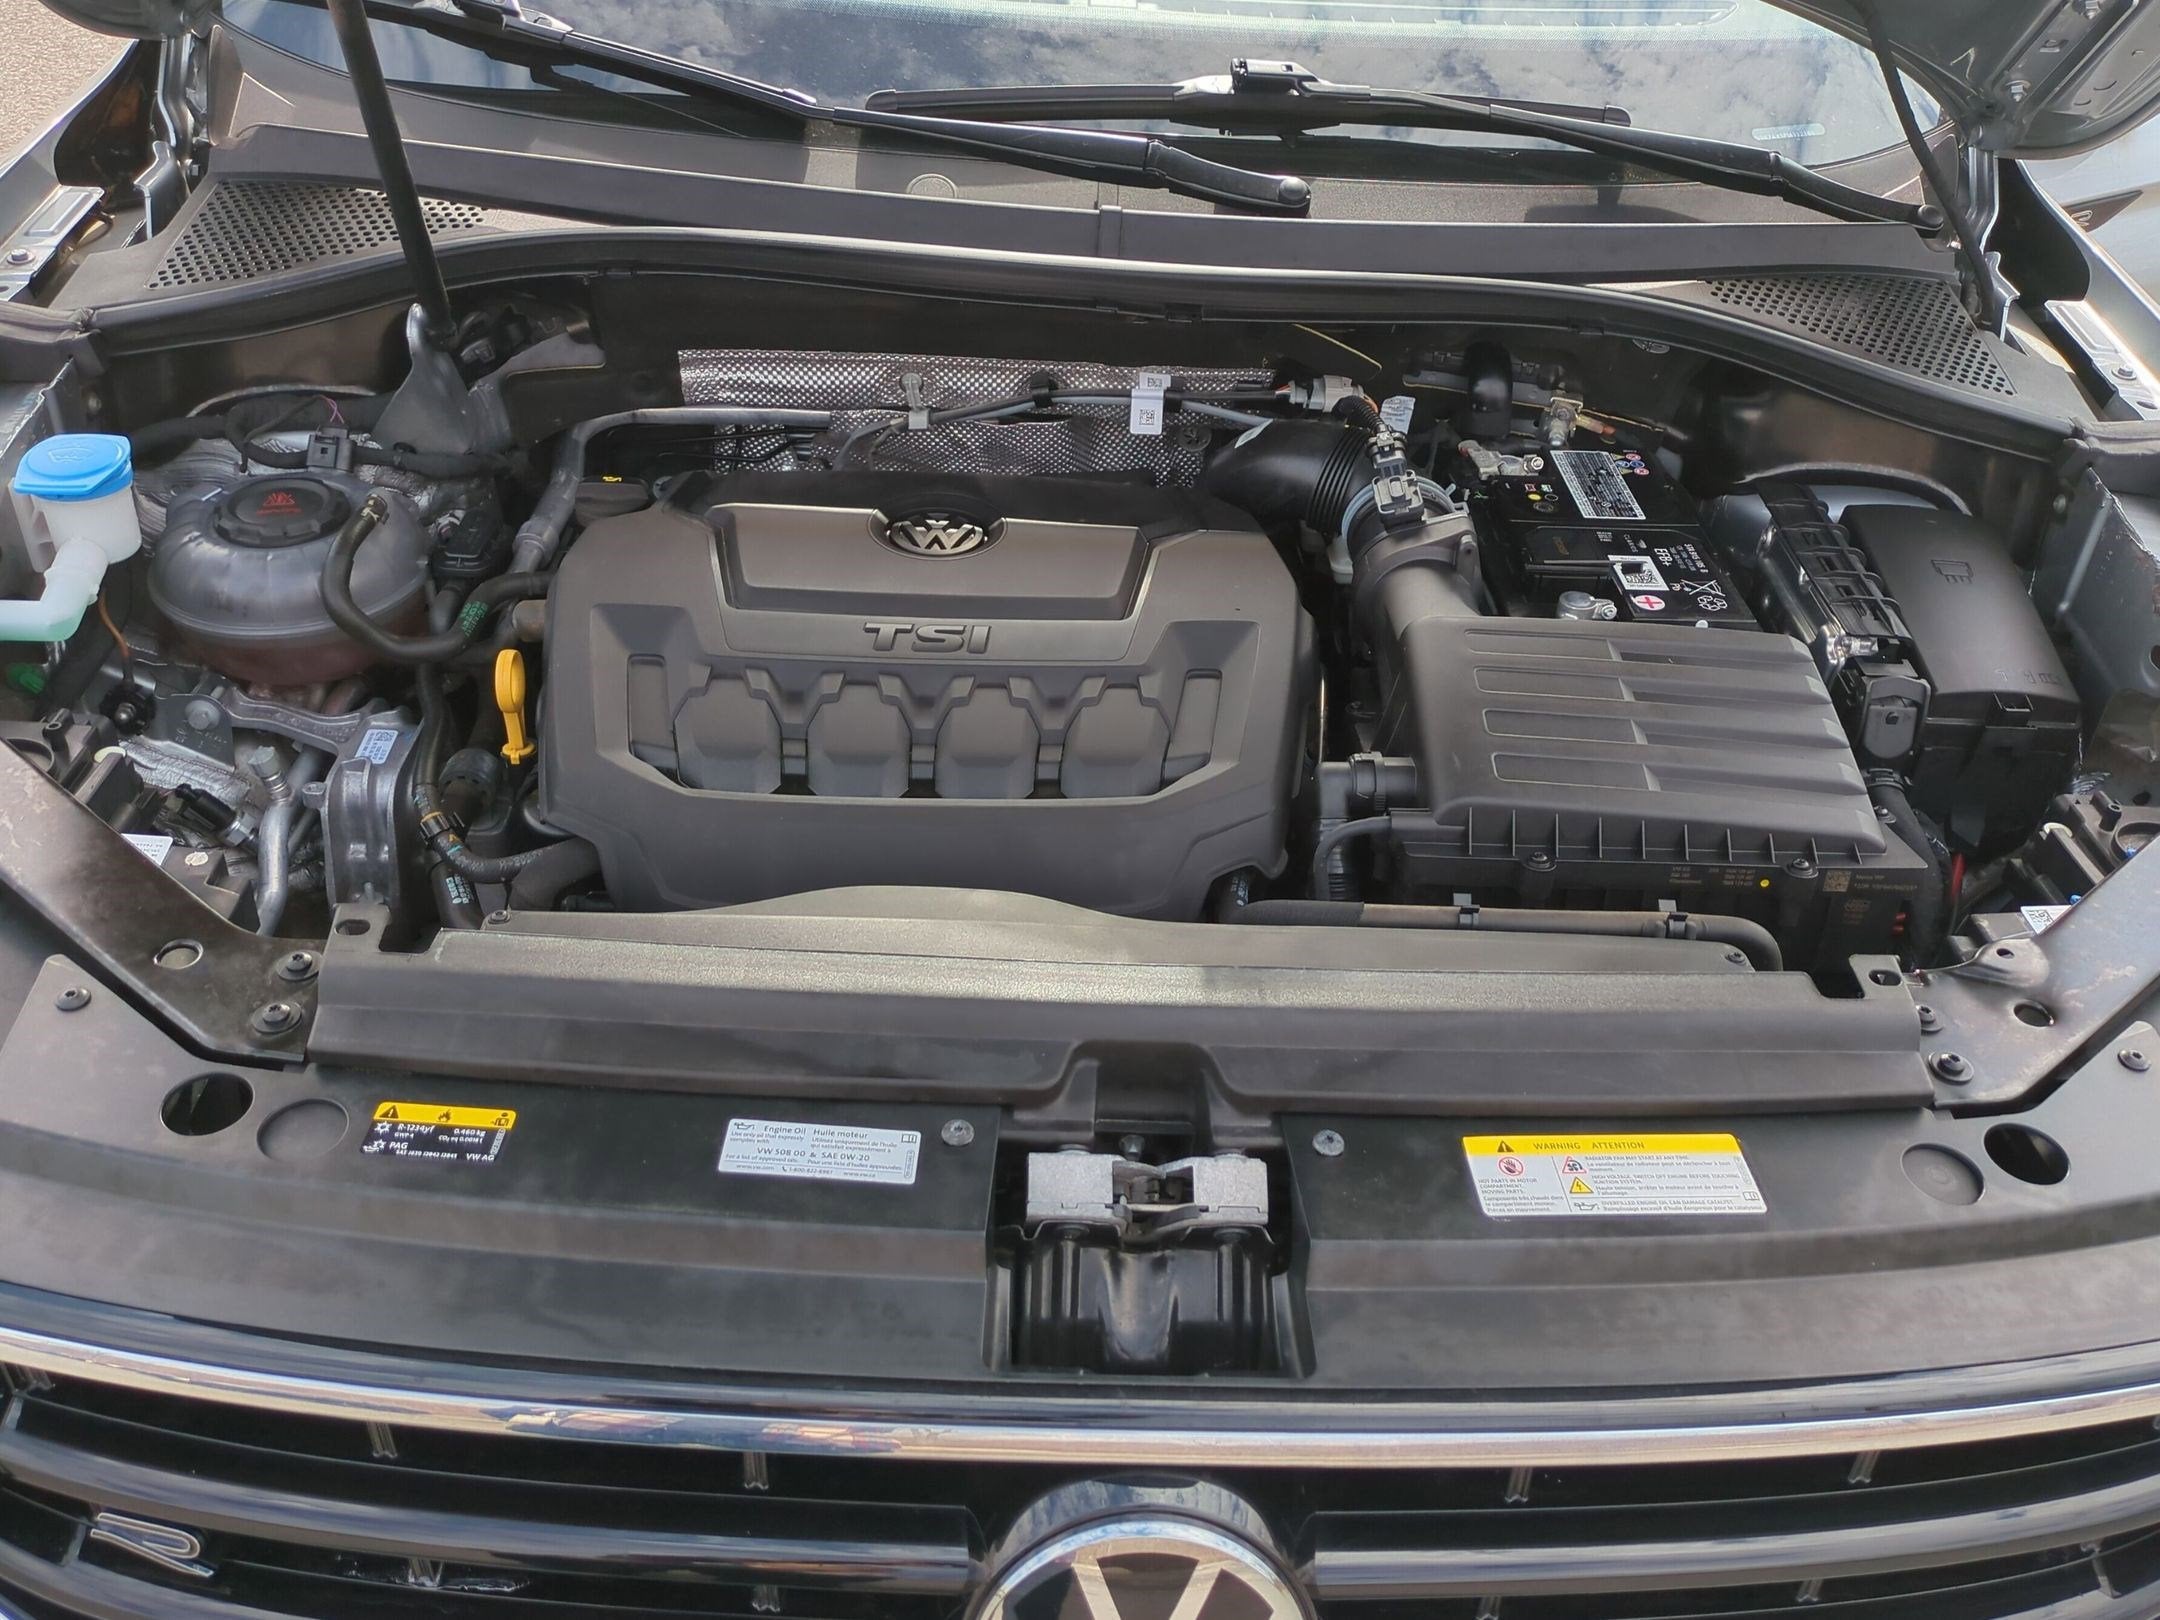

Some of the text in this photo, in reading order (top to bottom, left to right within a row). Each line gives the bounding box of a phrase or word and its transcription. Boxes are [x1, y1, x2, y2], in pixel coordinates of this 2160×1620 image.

[1654, 548, 1673, 567] EFB+
[863, 622, 992, 654] TSI
[397, 1123, 436, 1134] R-1234yf
[476, 1129, 487, 1137] kg
[764, 1125, 807, 1135] Engine Oil
[813, 1128, 868, 1139] Huile moteur
[389, 1141, 409, 1149] PAG
[1533, 1142, 1645, 1150] WARNING ATTENTION
[775, 1148, 791, 1156] 508
